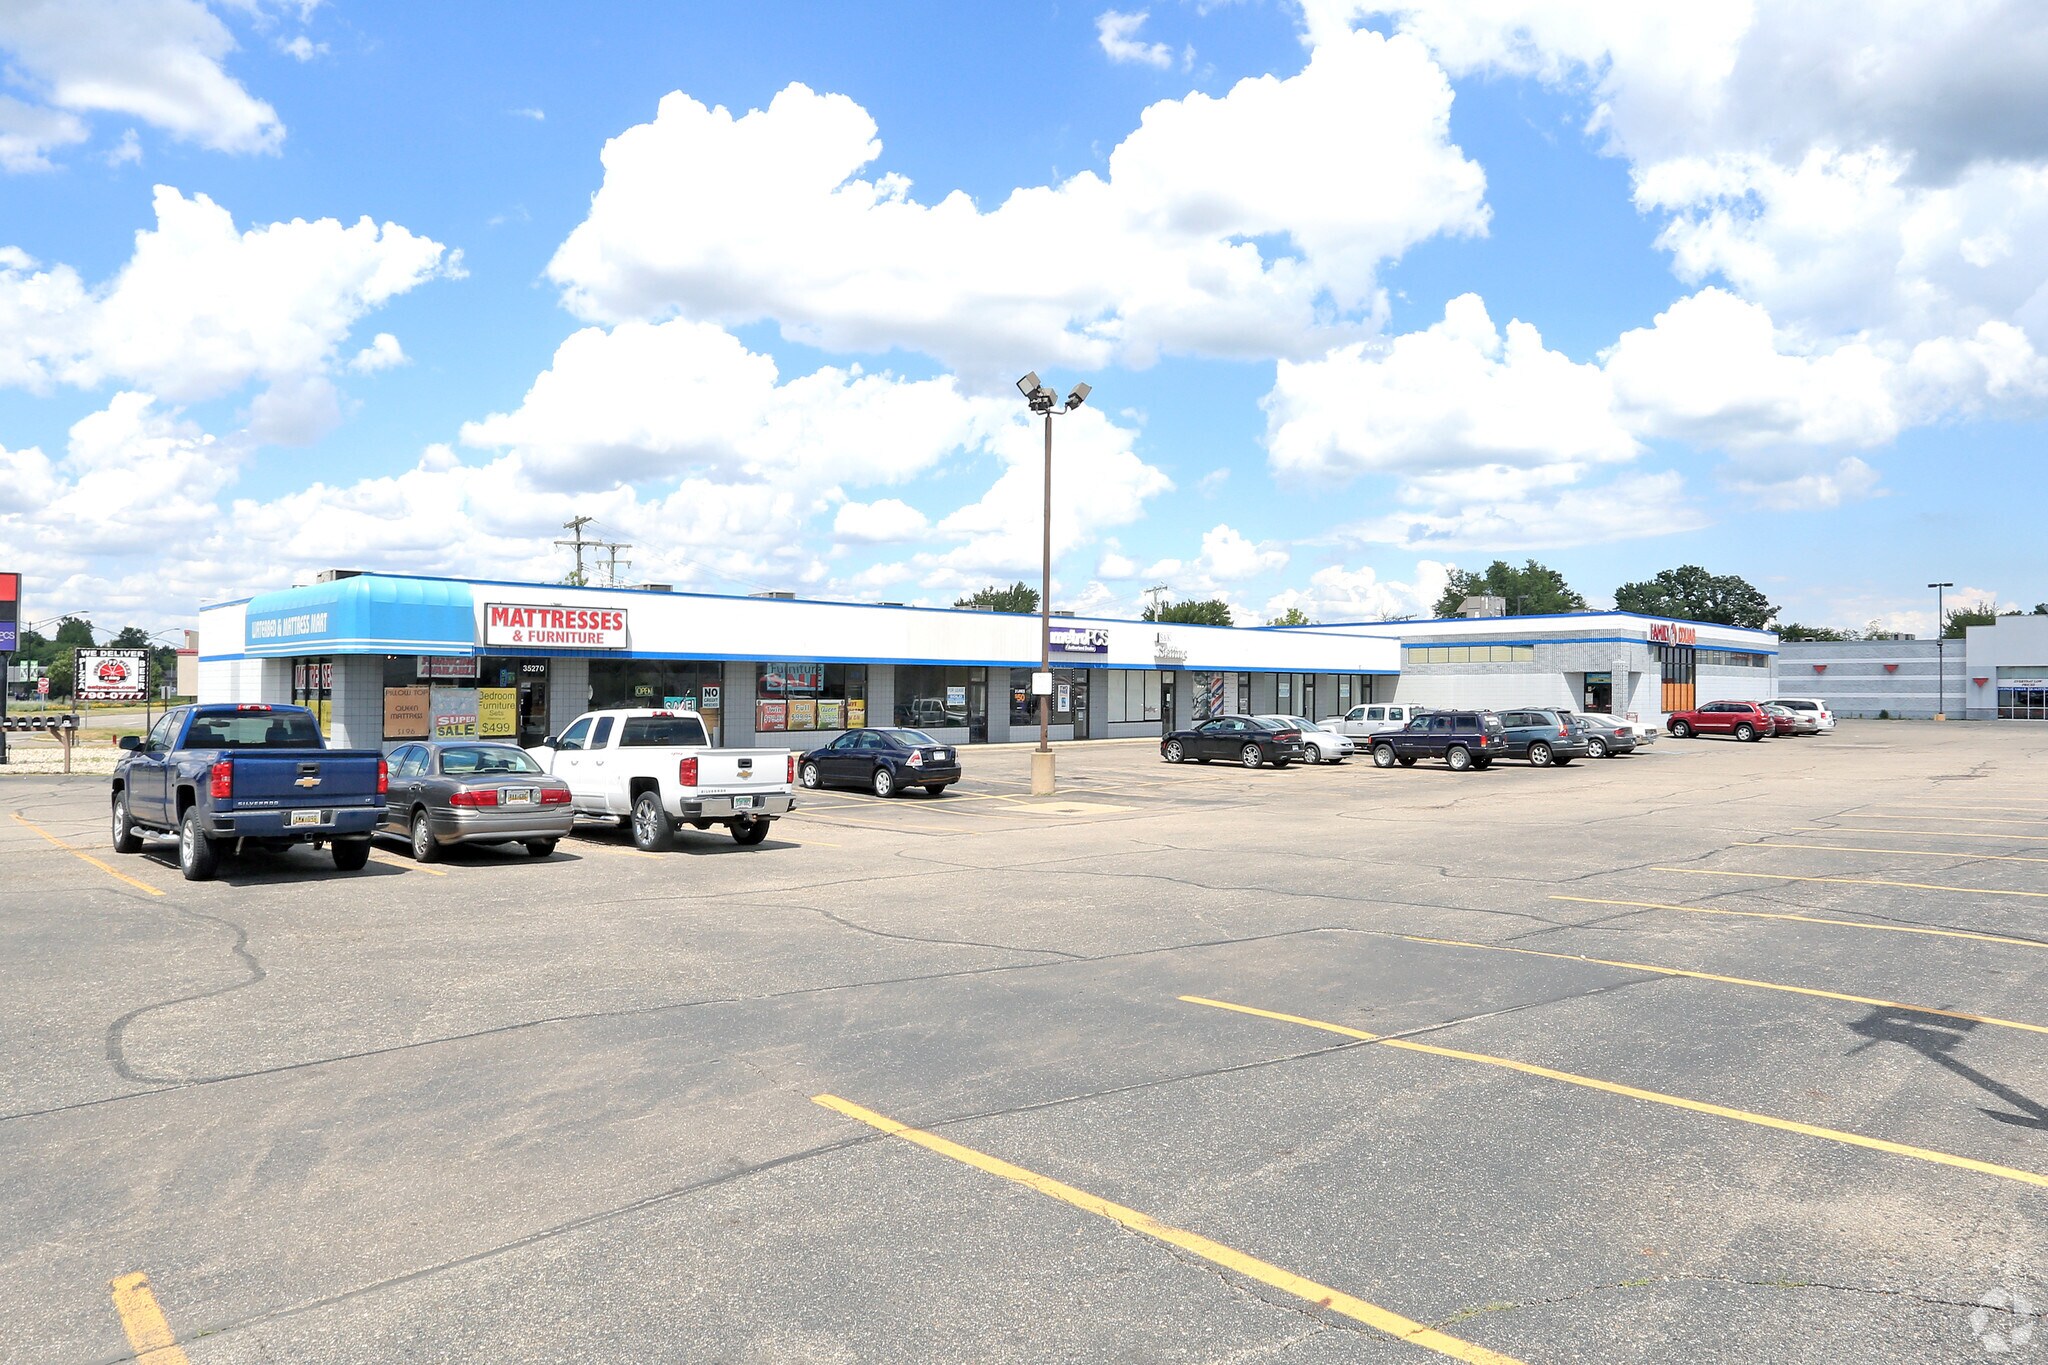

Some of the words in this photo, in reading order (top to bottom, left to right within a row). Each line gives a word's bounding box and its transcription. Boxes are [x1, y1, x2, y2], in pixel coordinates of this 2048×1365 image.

[283, 615, 310, 636] MATTRESS
[311, 612, 327, 633] MART
[491, 607, 624, 631] MATTRESSES
[512, 630, 523, 642] &
[528, 630, 604, 644] FURNITURE
[479, 691, 515, 700] Bedroom
[704, 688, 718, 697] NO
[479, 701, 516, 709] Furniture
[795, 704, 809, 712] Full
[438, 716, 476, 725] SUPER
[438, 723, 475, 736] SALE
[482, 722, 510, 733] $499
